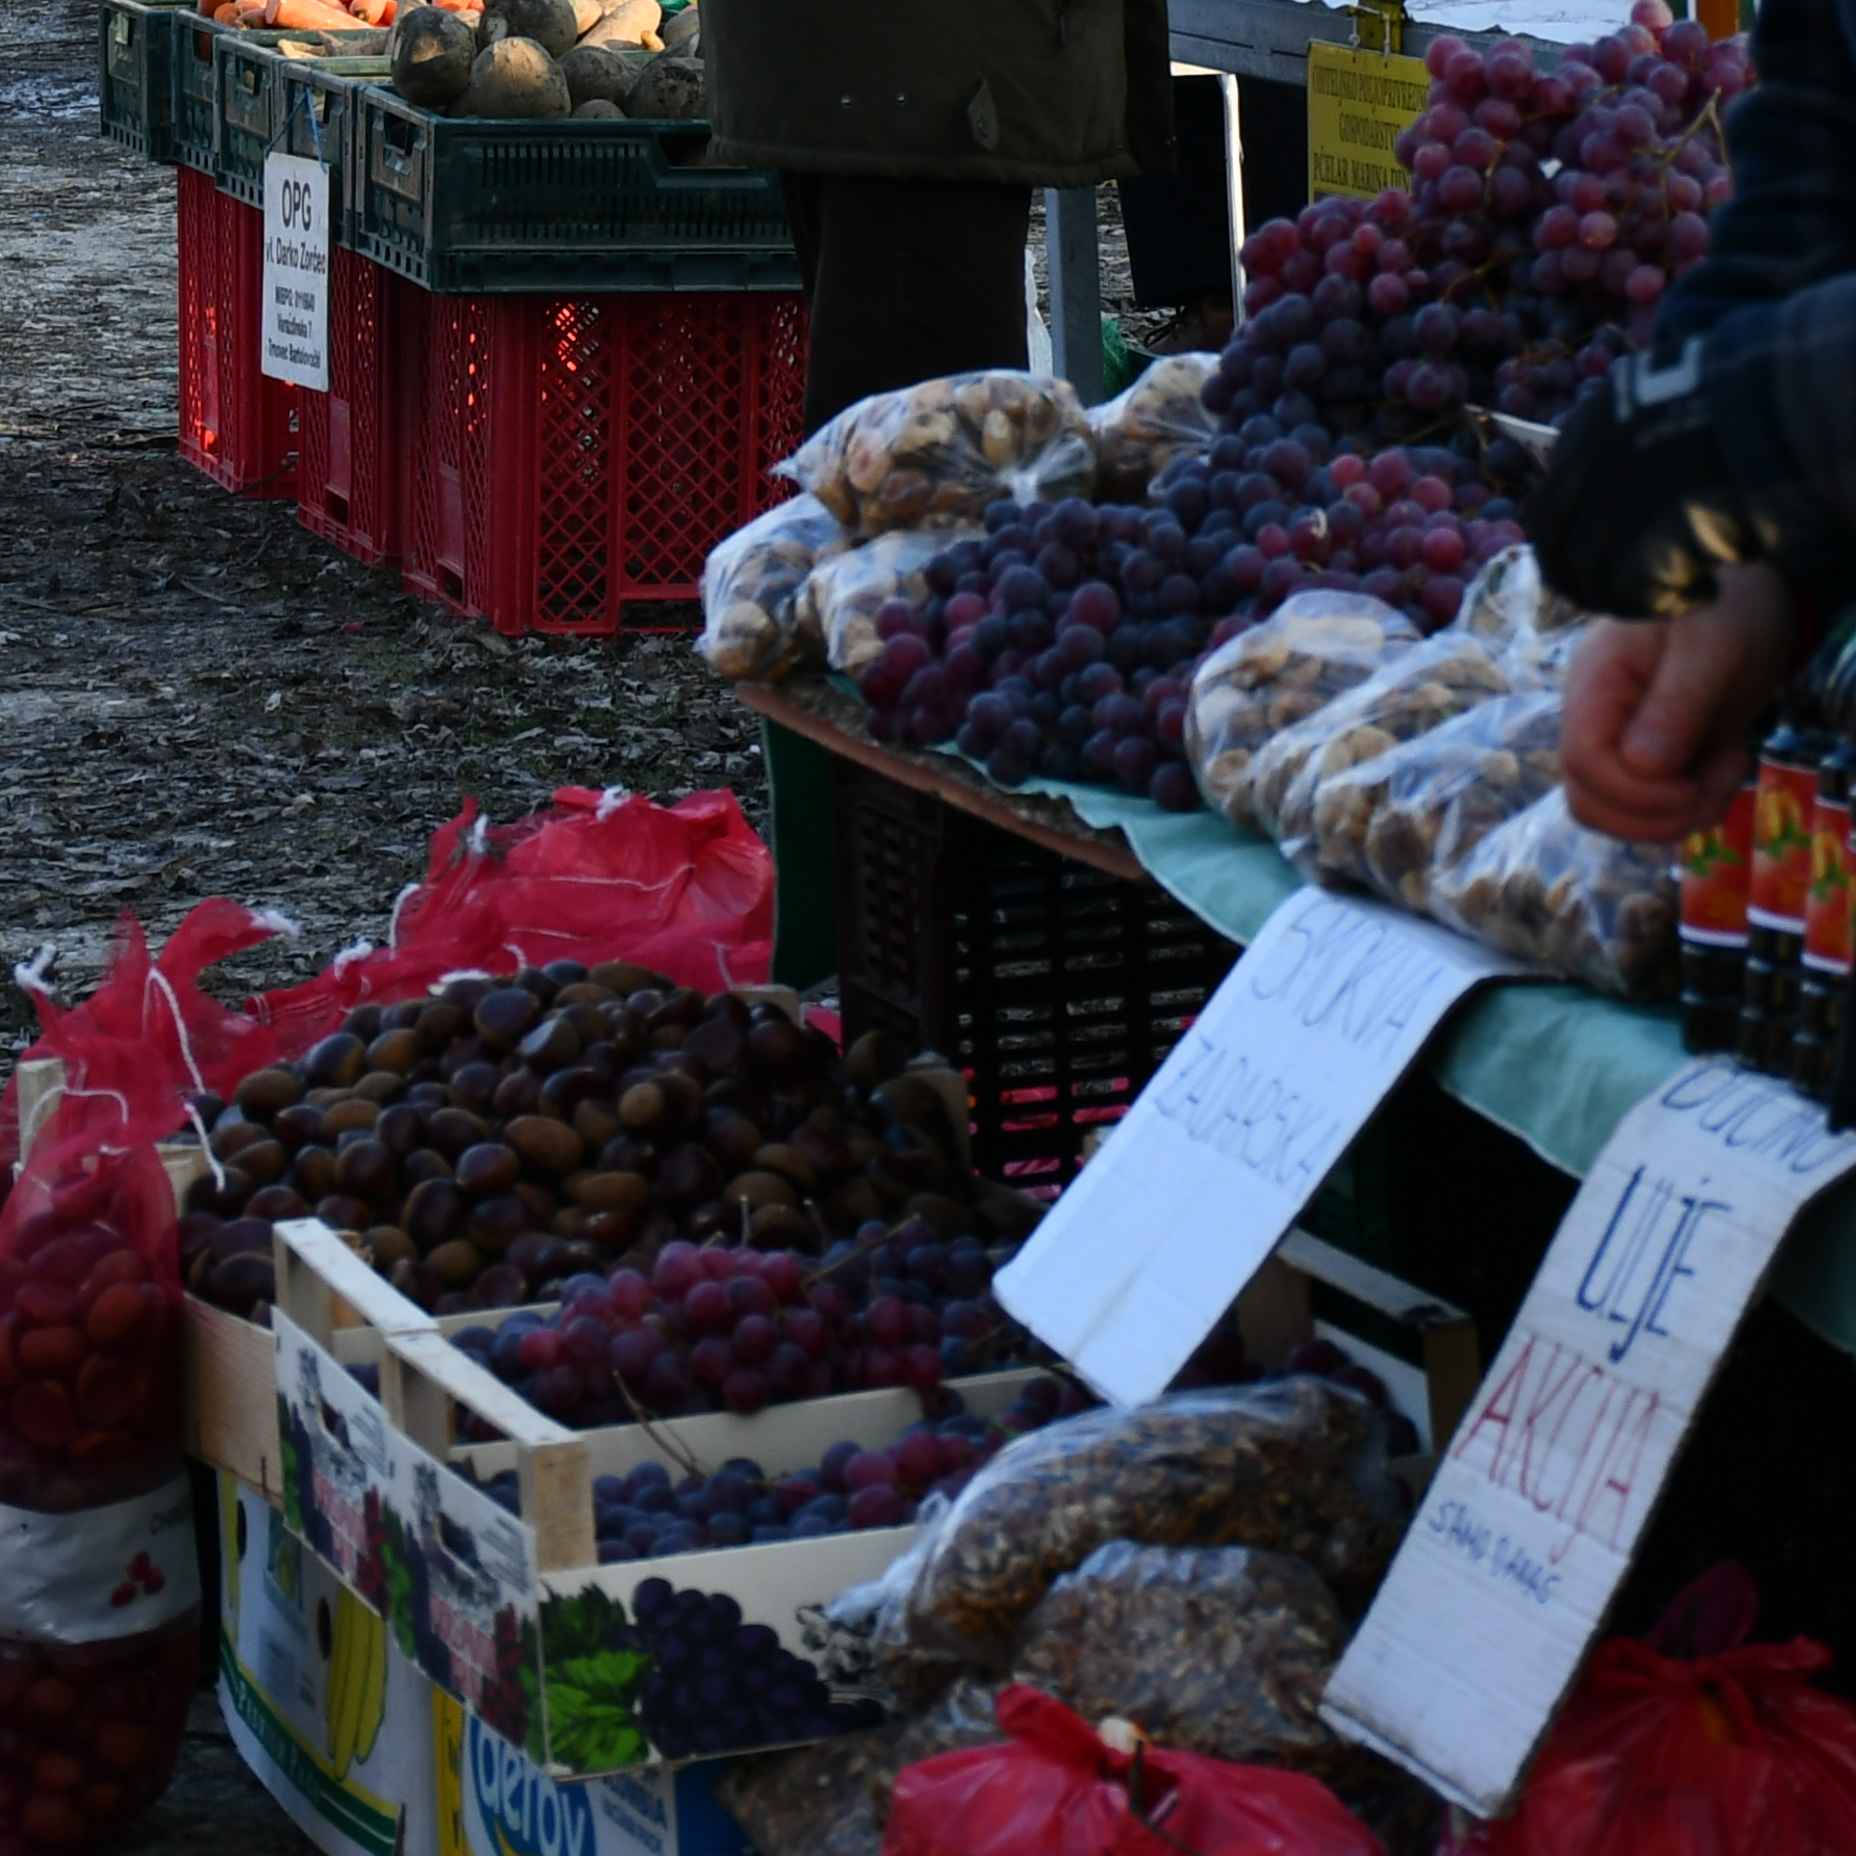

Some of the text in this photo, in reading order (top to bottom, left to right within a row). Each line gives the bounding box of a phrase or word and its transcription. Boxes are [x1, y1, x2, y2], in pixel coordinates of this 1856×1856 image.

[281, 179, 312, 231] OPG
[1576, 1165, 1732, 1364] ULJE
[1453, 1334, 1661, 1563] AKCIJA
